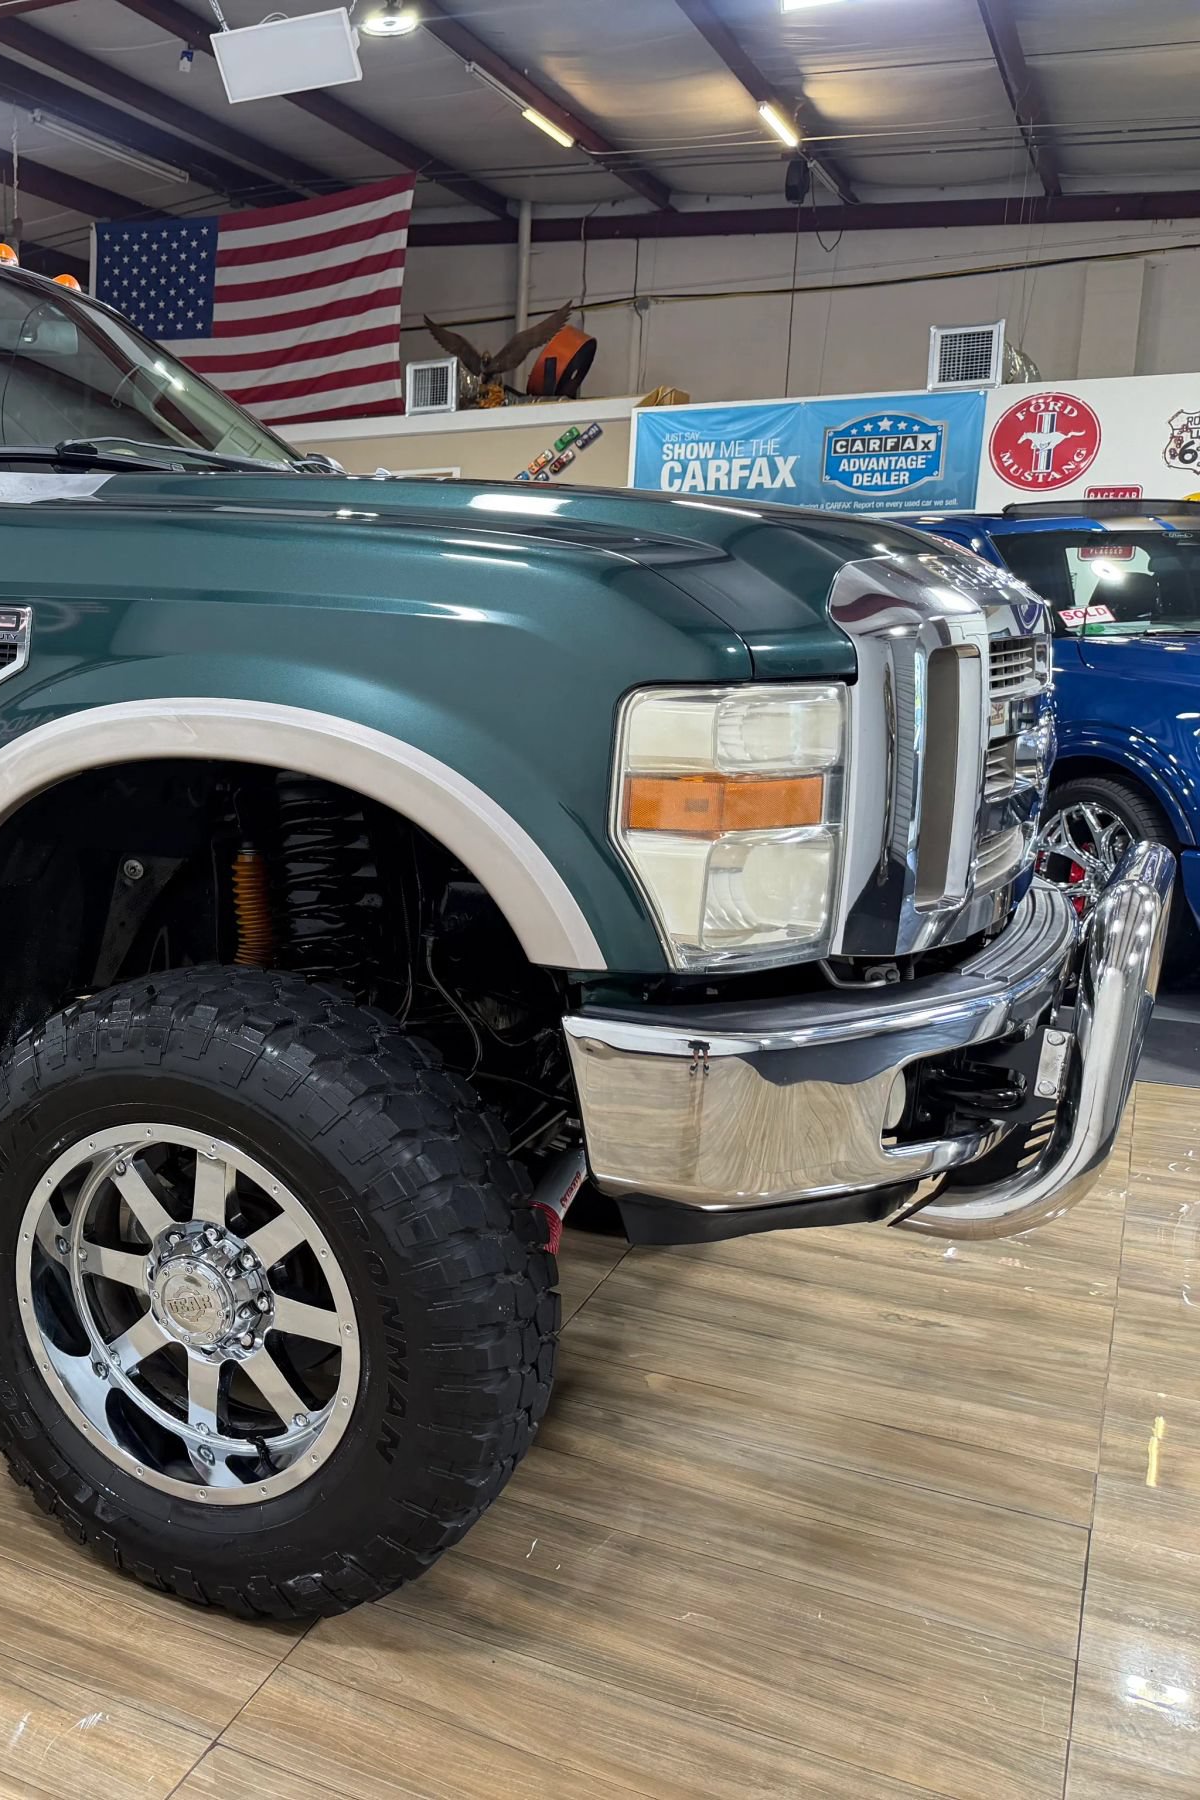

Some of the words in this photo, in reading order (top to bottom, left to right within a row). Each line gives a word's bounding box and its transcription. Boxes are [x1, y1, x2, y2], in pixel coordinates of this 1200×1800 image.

[1015, 401, 1078, 421] FORD
[663, 433, 682, 442] JUST
[684, 432, 701, 441] SAY
[834, 436, 933, 453] CARFAX
[662, 442, 715, 460] SHOW
[720, 440, 744, 458] ME
[751, 438, 780, 456] THE
[838, 455, 926, 472] ADVANTAGE
[1000, 447, 1087, 483] MUSTANG
[661, 455, 797, 492] CARFAX
[852, 471, 910, 487] DEALER
[853, 502, 875, 510] Report
[1062, 607, 1107, 621] SOLD
